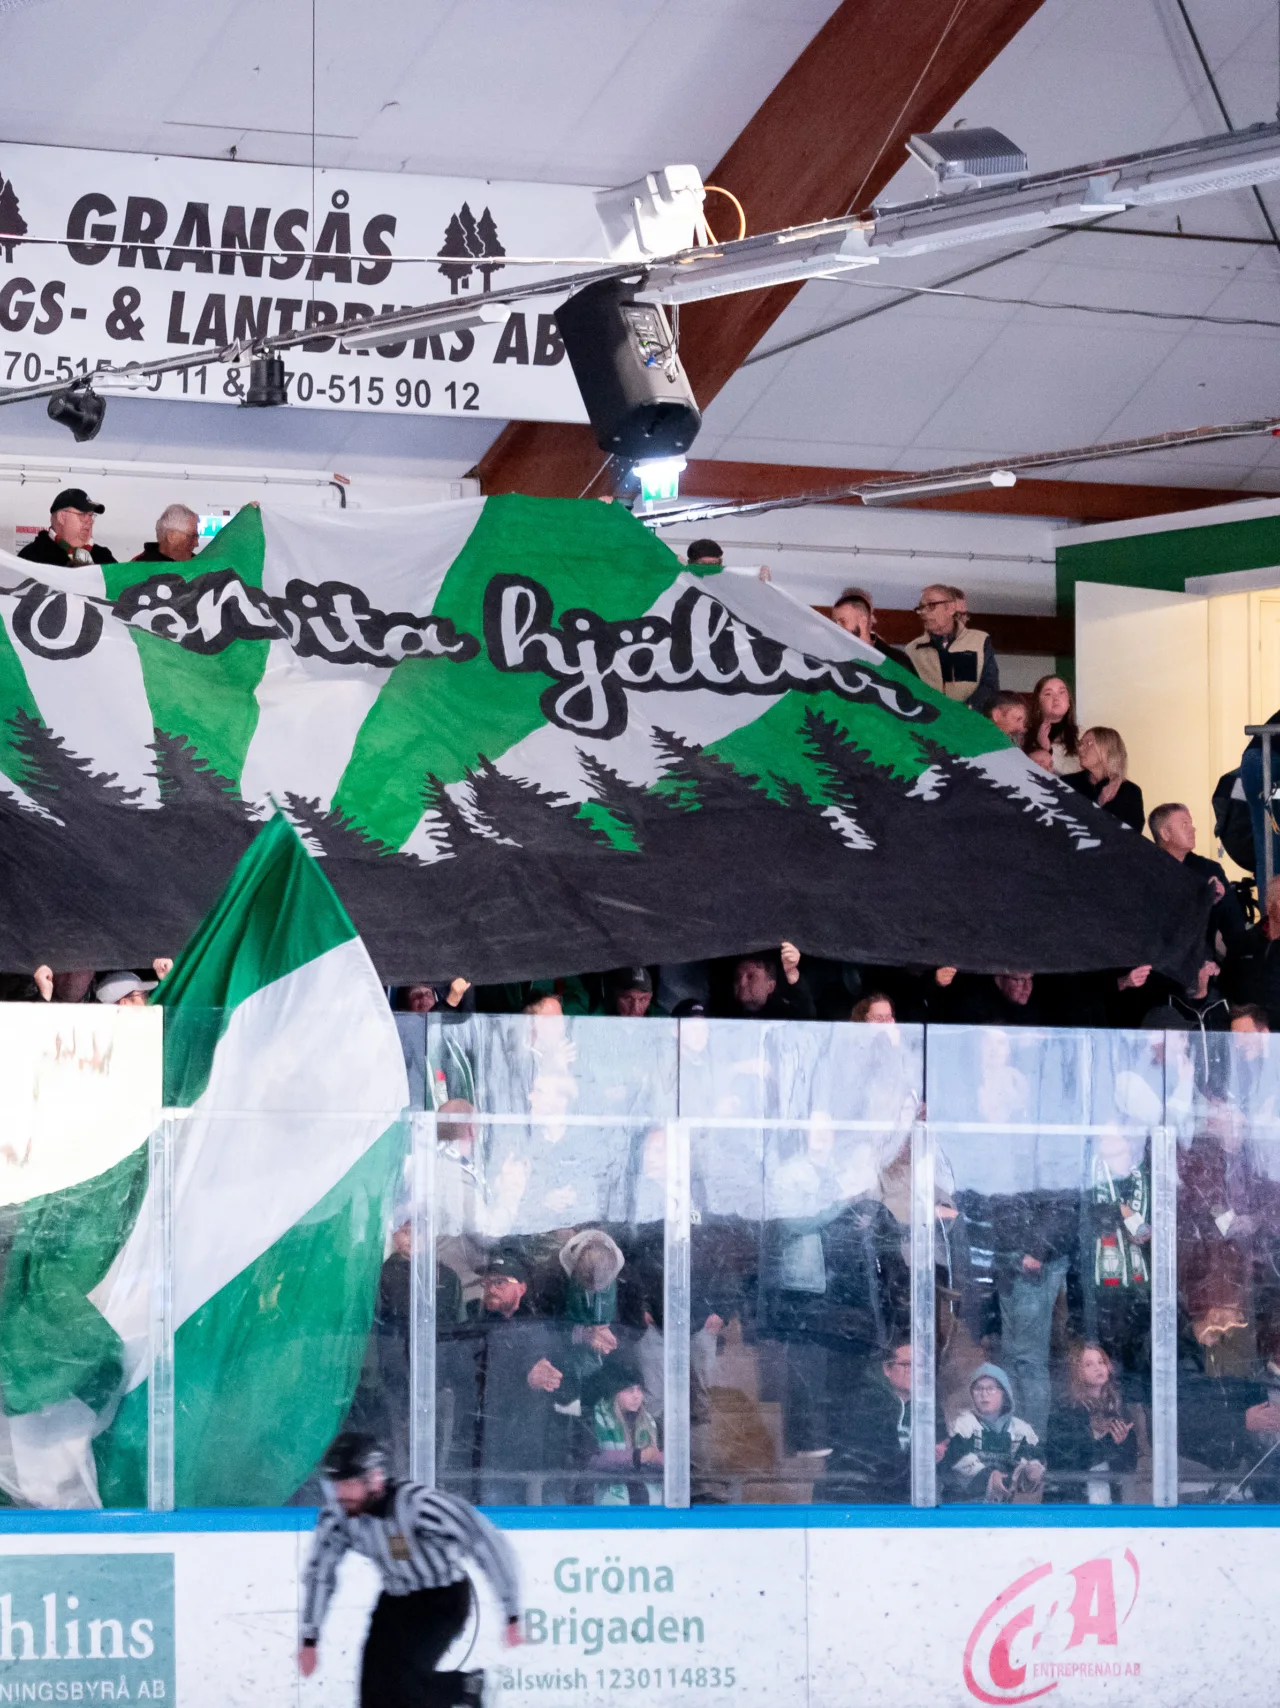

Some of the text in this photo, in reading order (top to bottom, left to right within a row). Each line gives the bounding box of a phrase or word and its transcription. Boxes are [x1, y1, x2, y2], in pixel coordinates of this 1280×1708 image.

[66, 189, 398, 286] GRANSÅS
[105, 286, 145, 341] &
[492, 312, 566, 366] AB
[176, 362, 208, 395] 11
[223, 367, 246, 398] &
[283, 371, 385, 406] 70-515
[395, 378, 432, 409] 90
[444, 381, 480, 410] 12
[500, 584, 923, 730] hjältar
[553, 1555, 675, 1594] Gröna
[524, 1605, 705, 1656] Brigaden
[137, 1679, 166, 1699] AB
[500, 1666, 737, 1691] ålswish 1230114835
[1033, 1663, 1120, 1678] ENTREPRENAD
